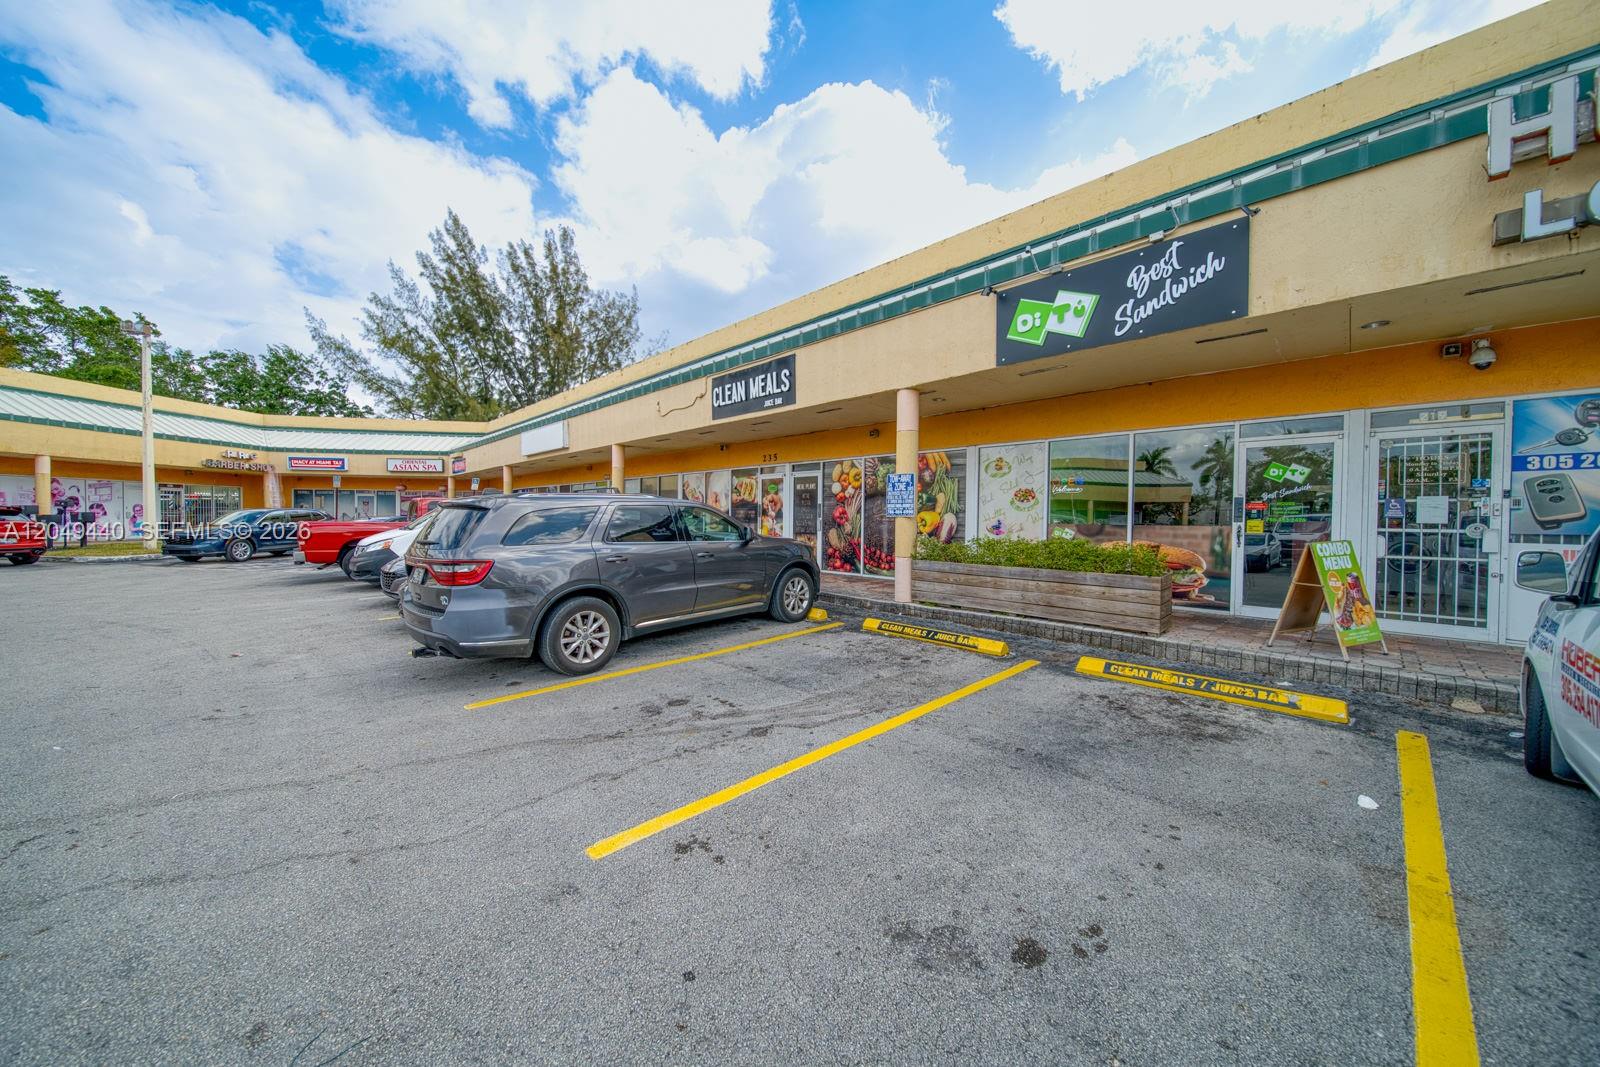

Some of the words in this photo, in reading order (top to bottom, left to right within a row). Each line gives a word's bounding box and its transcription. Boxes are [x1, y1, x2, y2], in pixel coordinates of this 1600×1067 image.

[1126, 240, 1185, 299] Best
[1113, 251, 1226, 337] Sandwich
[712, 380, 746, 408] CLEAN
[749, 369, 790, 400] MEALS
[762, 453, 778, 462] 235
[1526, 455, 1575, 471] 305
[1279, 482, 1313, 498] Sandwich
[1316, 542, 1351, 556] COMBO
[1322, 555, 1353, 571] MENU
[881, 623, 903, 632] CLEAN
[904, 627, 928, 637] MEALS
[934, 631, 956, 643] JUICE
[1110, 664, 1148, 678] CLEAN
[1151, 671, 1195, 687] MEALS
